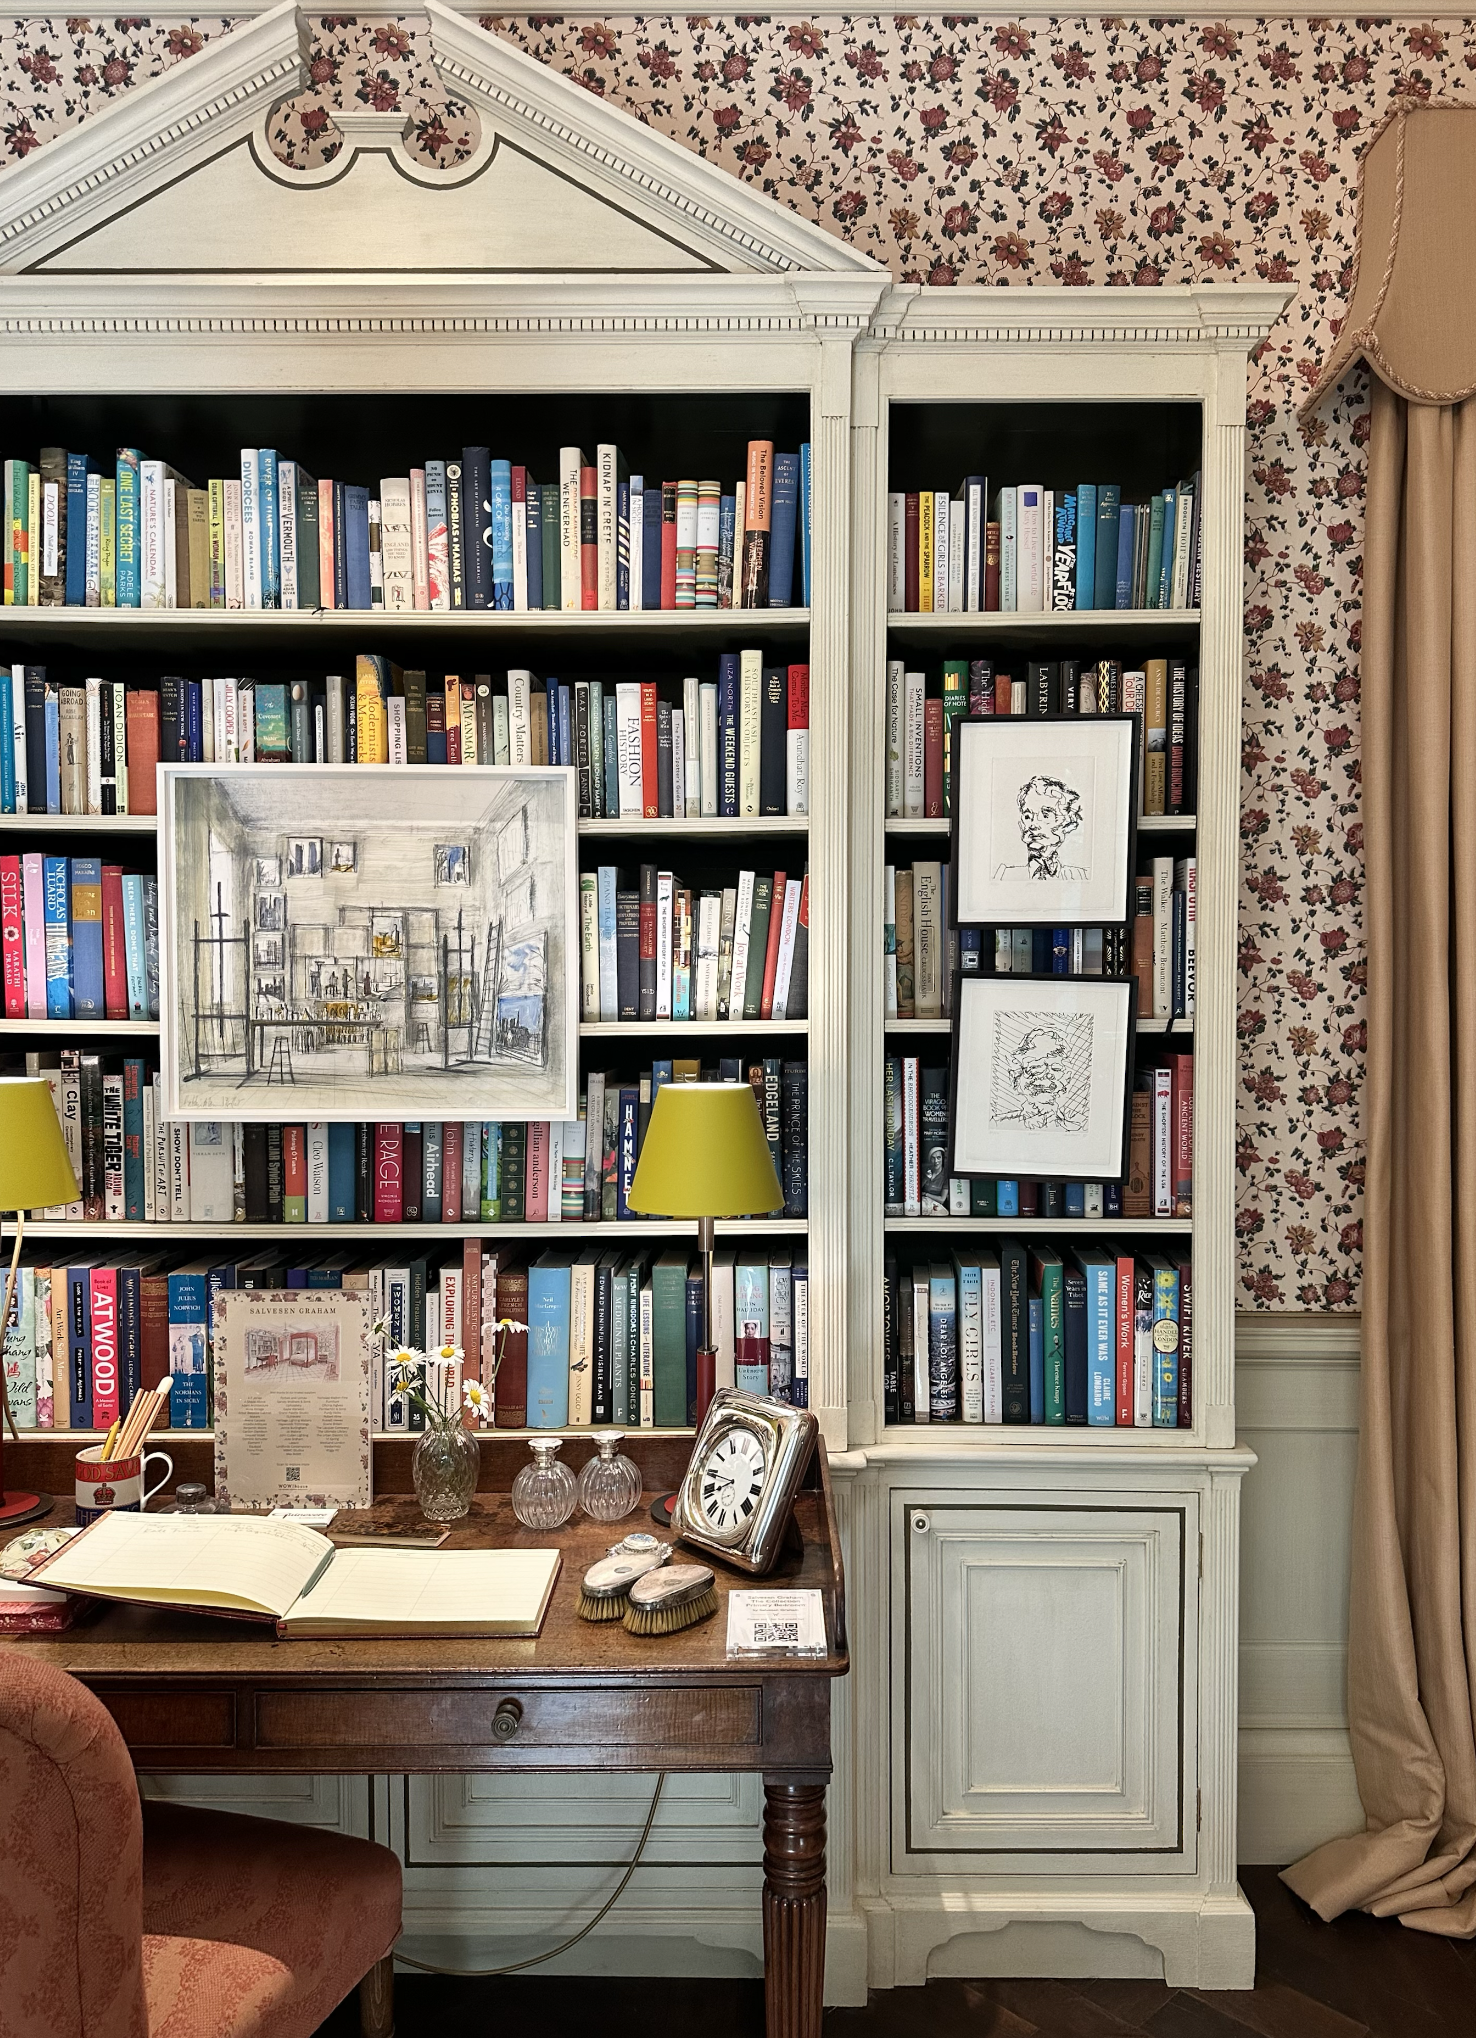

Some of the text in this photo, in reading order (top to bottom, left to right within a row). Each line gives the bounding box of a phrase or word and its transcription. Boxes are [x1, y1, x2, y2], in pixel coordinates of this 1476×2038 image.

[603, 453, 611, 492] KIDNAP
[759, 465, 767, 495] Beloved
[47, 494, 55, 526] DOOM
[120, 472, 133, 563] ONE LAST SECRET
[451, 492, 459, 536] PHOBIAS
[603, 496, 611, 506] IN
[938, 501, 946, 534] SILENCE
[1064, 494, 1076, 542] MARGARET
[281, 513, 294, 562] VERMOUTH
[1056, 507, 1067, 544] ATWOOD
[452, 543, 461, 582] MANIAS
[937, 576, 945, 609] BARKER
[225, 685, 233, 704] JILLY
[1171, 667, 1184, 743] THE HISTORY OF IDEAS
[115, 689, 124, 762] JOAN DIDION
[358, 704, 366, 763] Mavericks
[369, 694, 378, 762] Modernists
[513, 678, 526, 763] Country Matters
[579, 725, 587, 762] PORTER
[619, 730, 627, 776] HISTORY
[627, 717, 640, 786] FASHION
[725, 728, 735, 769] WEEKEND
[580, 772, 588, 801] LANNY
[725, 771, 735, 803] GUESTS
[1171, 746, 1183, 804] DAVID RUNCIMAN
[2, 872, 17, 919] SILK
[47, 872, 56, 910] LUARD
[57, 863, 65, 918] NICHOLAS
[1160, 870, 1168, 913] The Walker
[584, 917, 592, 931] The
[784, 916, 794, 945] LONDON
[918, 876, 931, 954] English House
[733, 942, 748, 998] Joy at Work
[1160, 923, 1168, 994] Matthew Beaumont
[65, 1090, 77, 1120] Clay
[765, 1075, 779, 1140] EDGELAND
[104, 1094, 122, 1171] WHITE TIGER
[157, 1136, 166, 1168] PURSUIT
[791, 1083, 802, 1194] THE PRINCE OF THE SKIES
[312, 1141, 323, 1195] Cleo Watson
[380, 1140, 399, 1189] RAGE
[426, 1142, 439, 1198] Airhead
[531, 1122, 542, 1199] gillian anderson
[158, 1178, 166, 1196] ART
[965, 1292, 978, 1322] FLY
[1009, 1260, 1020, 1330] The New York Times
[1050, 1289, 1062, 1328] Names
[1098, 1271, 1108, 1361] SAME AS IT EVER WAS
[1120, 1275, 1130, 1348] Women's Work
[94, 1292, 115, 1395] ATWOOD
[615, 1297, 623, 1349] MEDICINAL
[801, 1321, 806, 1330] OF
[56, 1342, 64, 1358] Sally
[1094, 1372, 1103, 1406] LOMBARDO
[1103, 1378, 1111, 1400] CLAIRE
